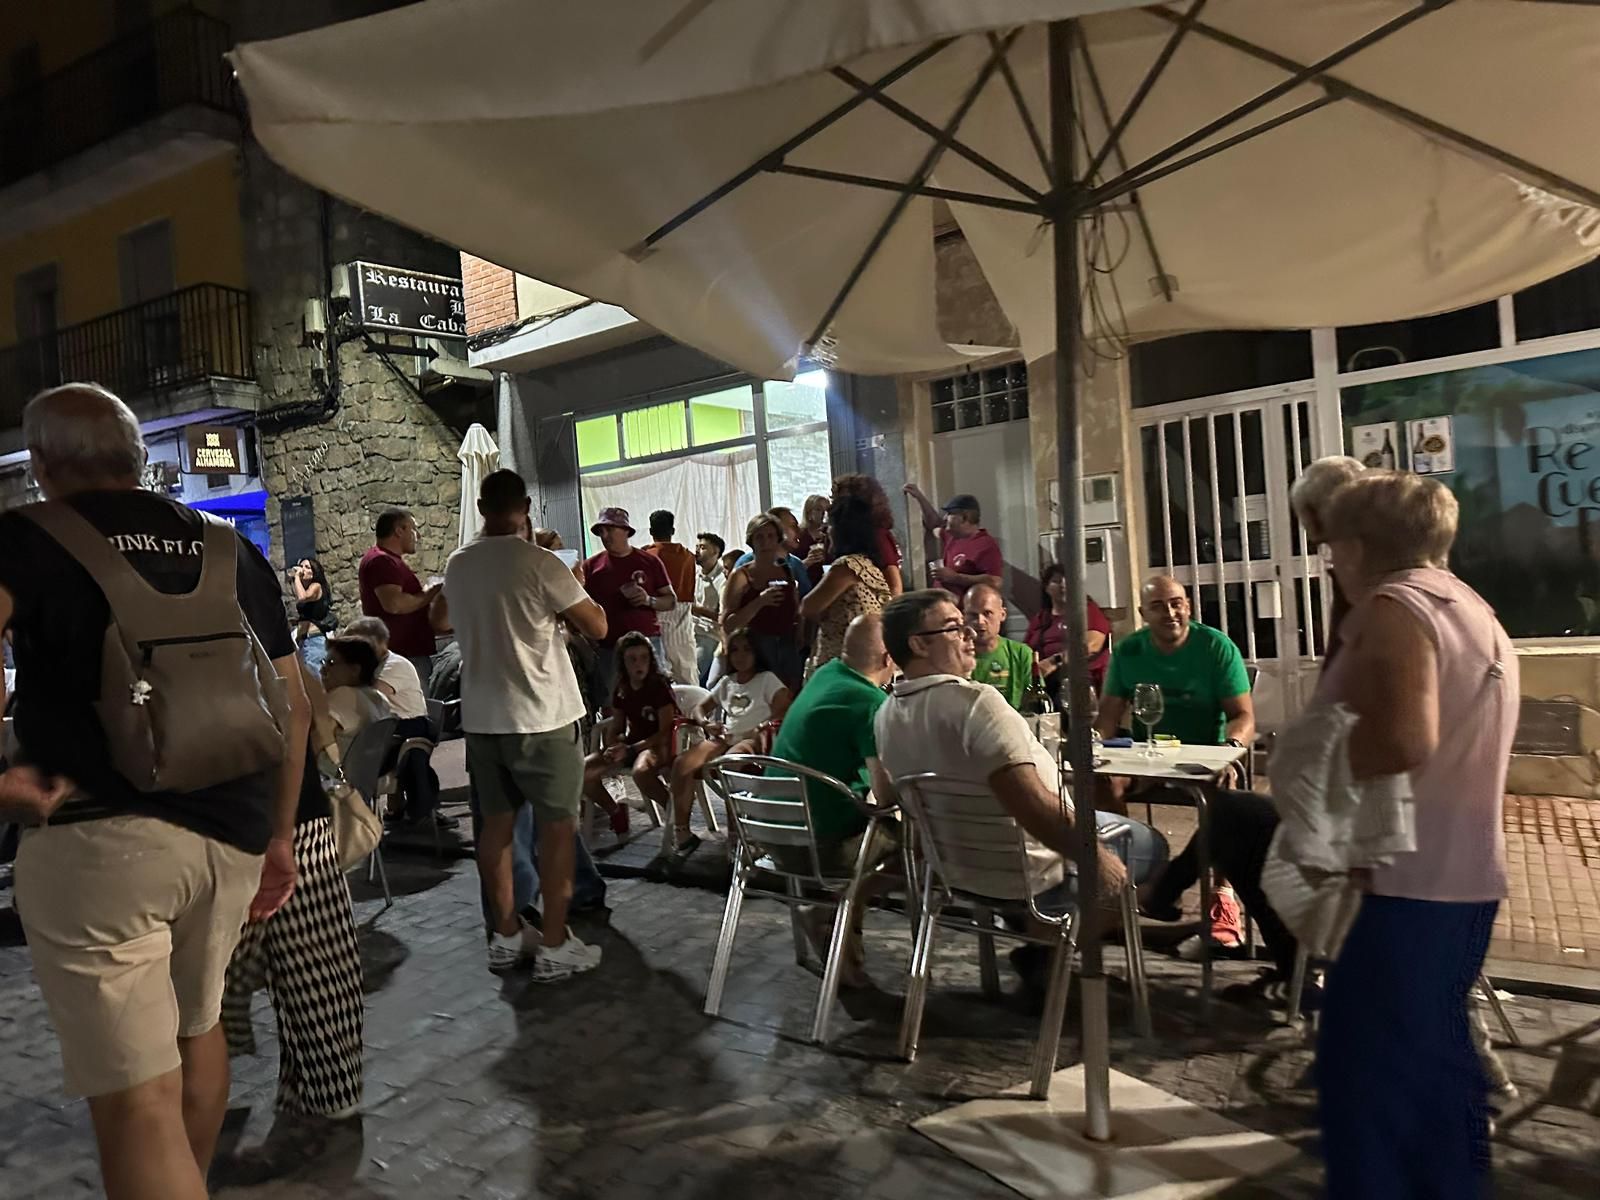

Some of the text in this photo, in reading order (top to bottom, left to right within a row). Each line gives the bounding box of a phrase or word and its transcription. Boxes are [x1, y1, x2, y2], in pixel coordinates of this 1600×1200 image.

[366, 268, 464, 297] Restaura
[367, 305, 400, 325] La
[196, 448, 232, 458] CERVEZAS
[196, 457, 235, 468] ALHAMBRA
[108, 534, 160, 552] INK
